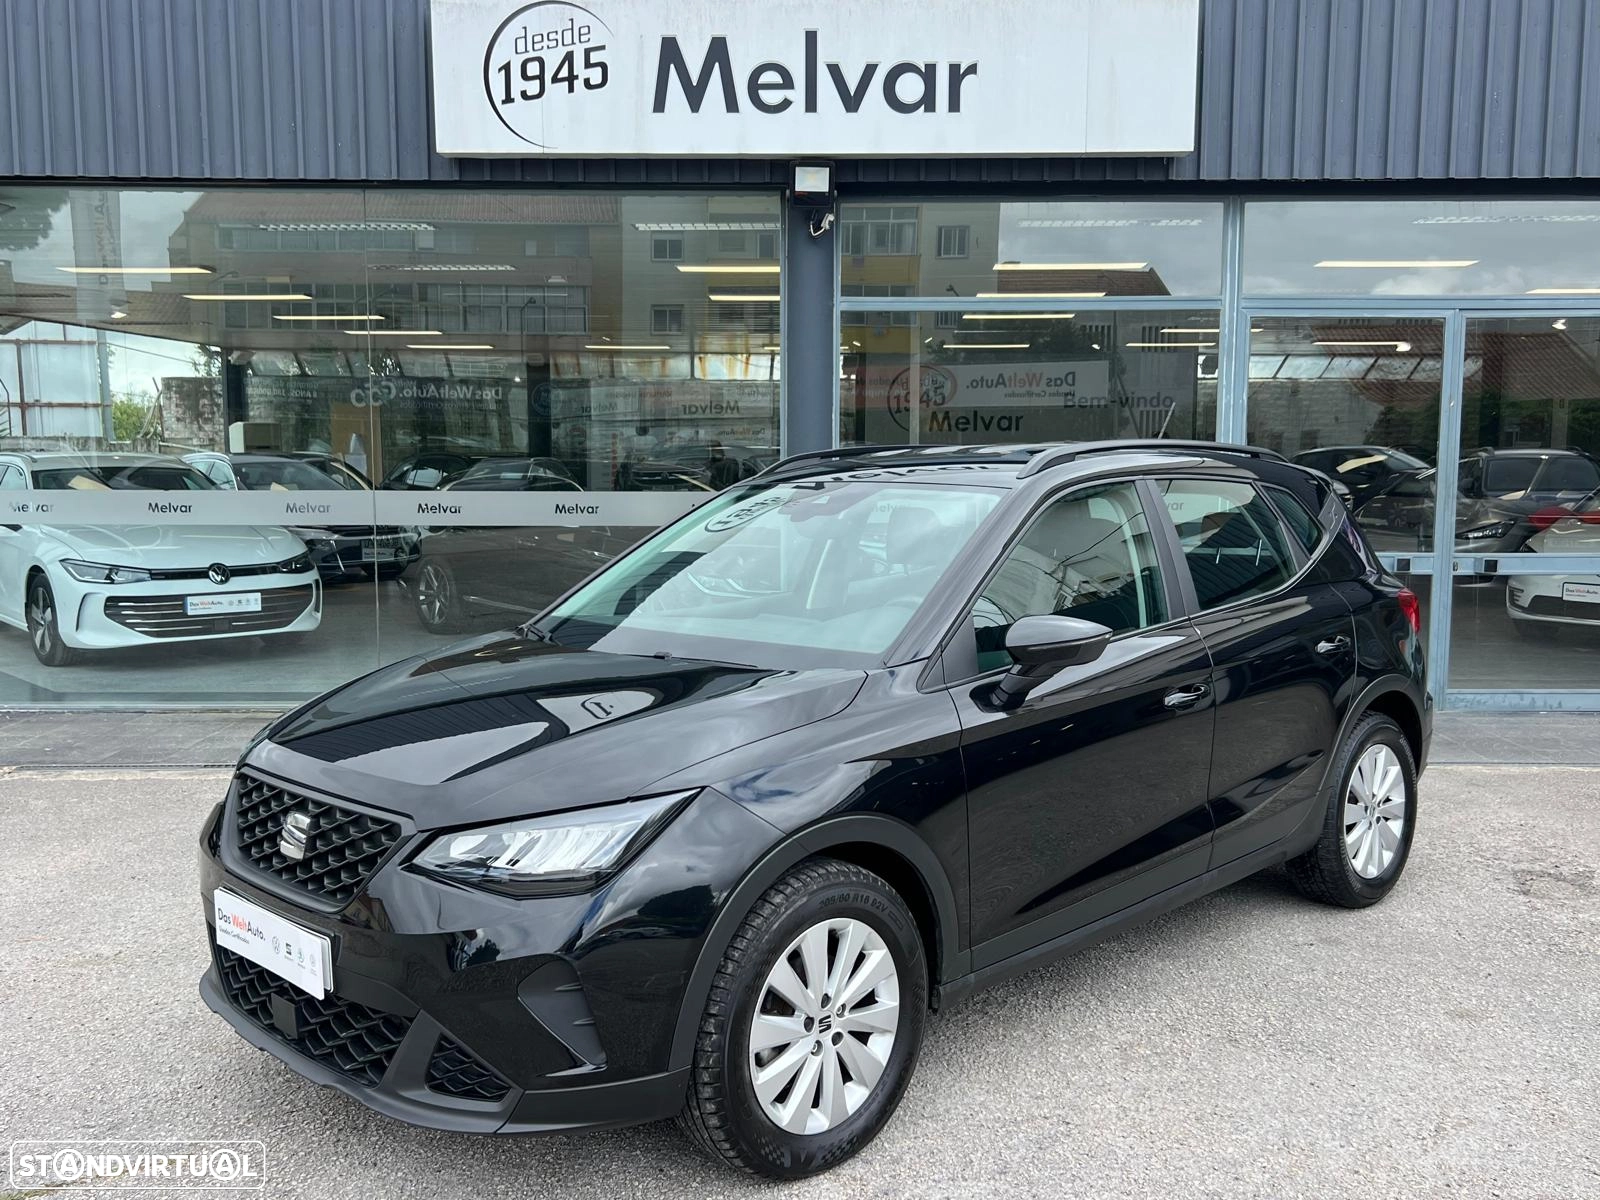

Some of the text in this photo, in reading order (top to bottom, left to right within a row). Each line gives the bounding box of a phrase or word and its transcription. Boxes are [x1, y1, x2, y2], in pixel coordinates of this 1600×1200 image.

[514, 18, 591, 55] desde
[498, 45, 609, 105] 1945
[652, 28, 978, 115] Melvar
[1064, 392, 1173, 409] Bem-vindo
[929, 411, 1024, 432] Melvar
[148, 502, 192, 513] Melvar
[285, 502, 331, 514] Melvar
[417, 502, 462, 514] Melvar
[554, 502, 599, 514] Melvar
[218, 908, 231, 925] Das
[231, 913, 266, 942] WeltAuto.
